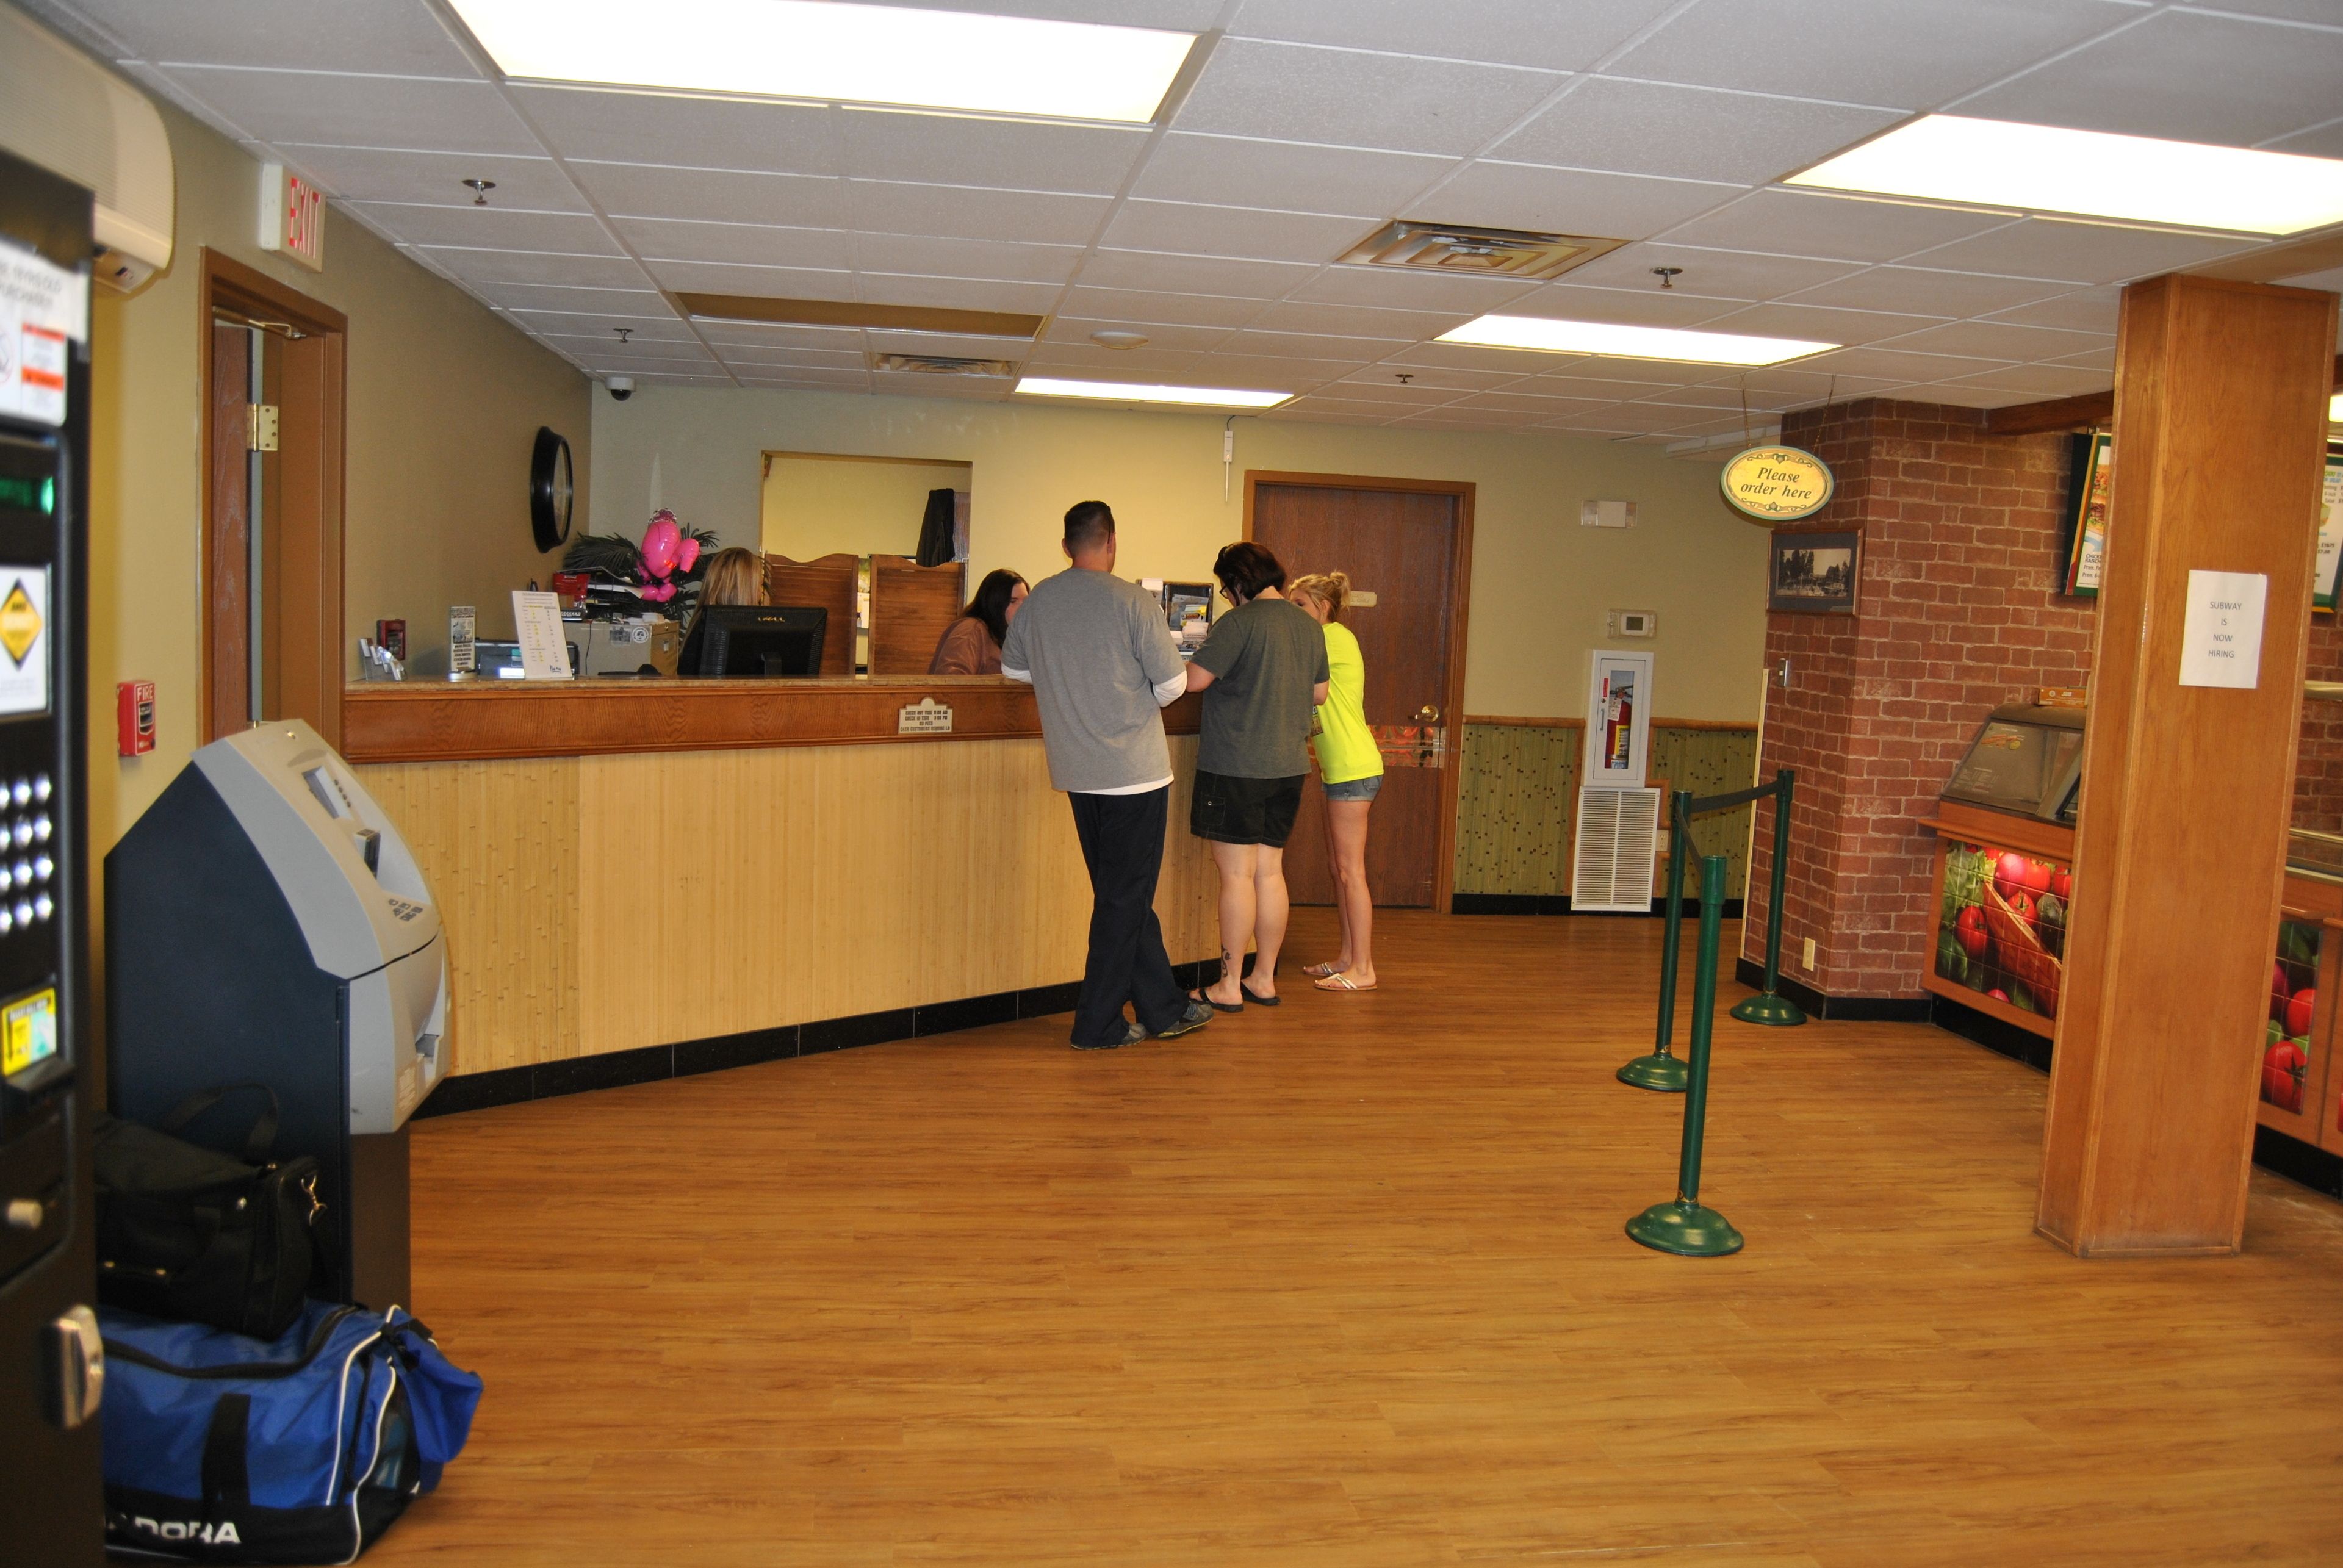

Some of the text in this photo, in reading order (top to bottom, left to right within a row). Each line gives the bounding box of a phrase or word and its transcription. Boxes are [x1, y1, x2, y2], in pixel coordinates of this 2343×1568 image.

[289, 176, 321, 260] EXIT
[1757, 467, 1800, 483] Please
[1740, 483, 1812, 499] order here
[2209, 601, 2242, 610] SUBWAY
[2208, 649, 2234, 658] HIRING
[137, 685, 153, 701] FIRE
